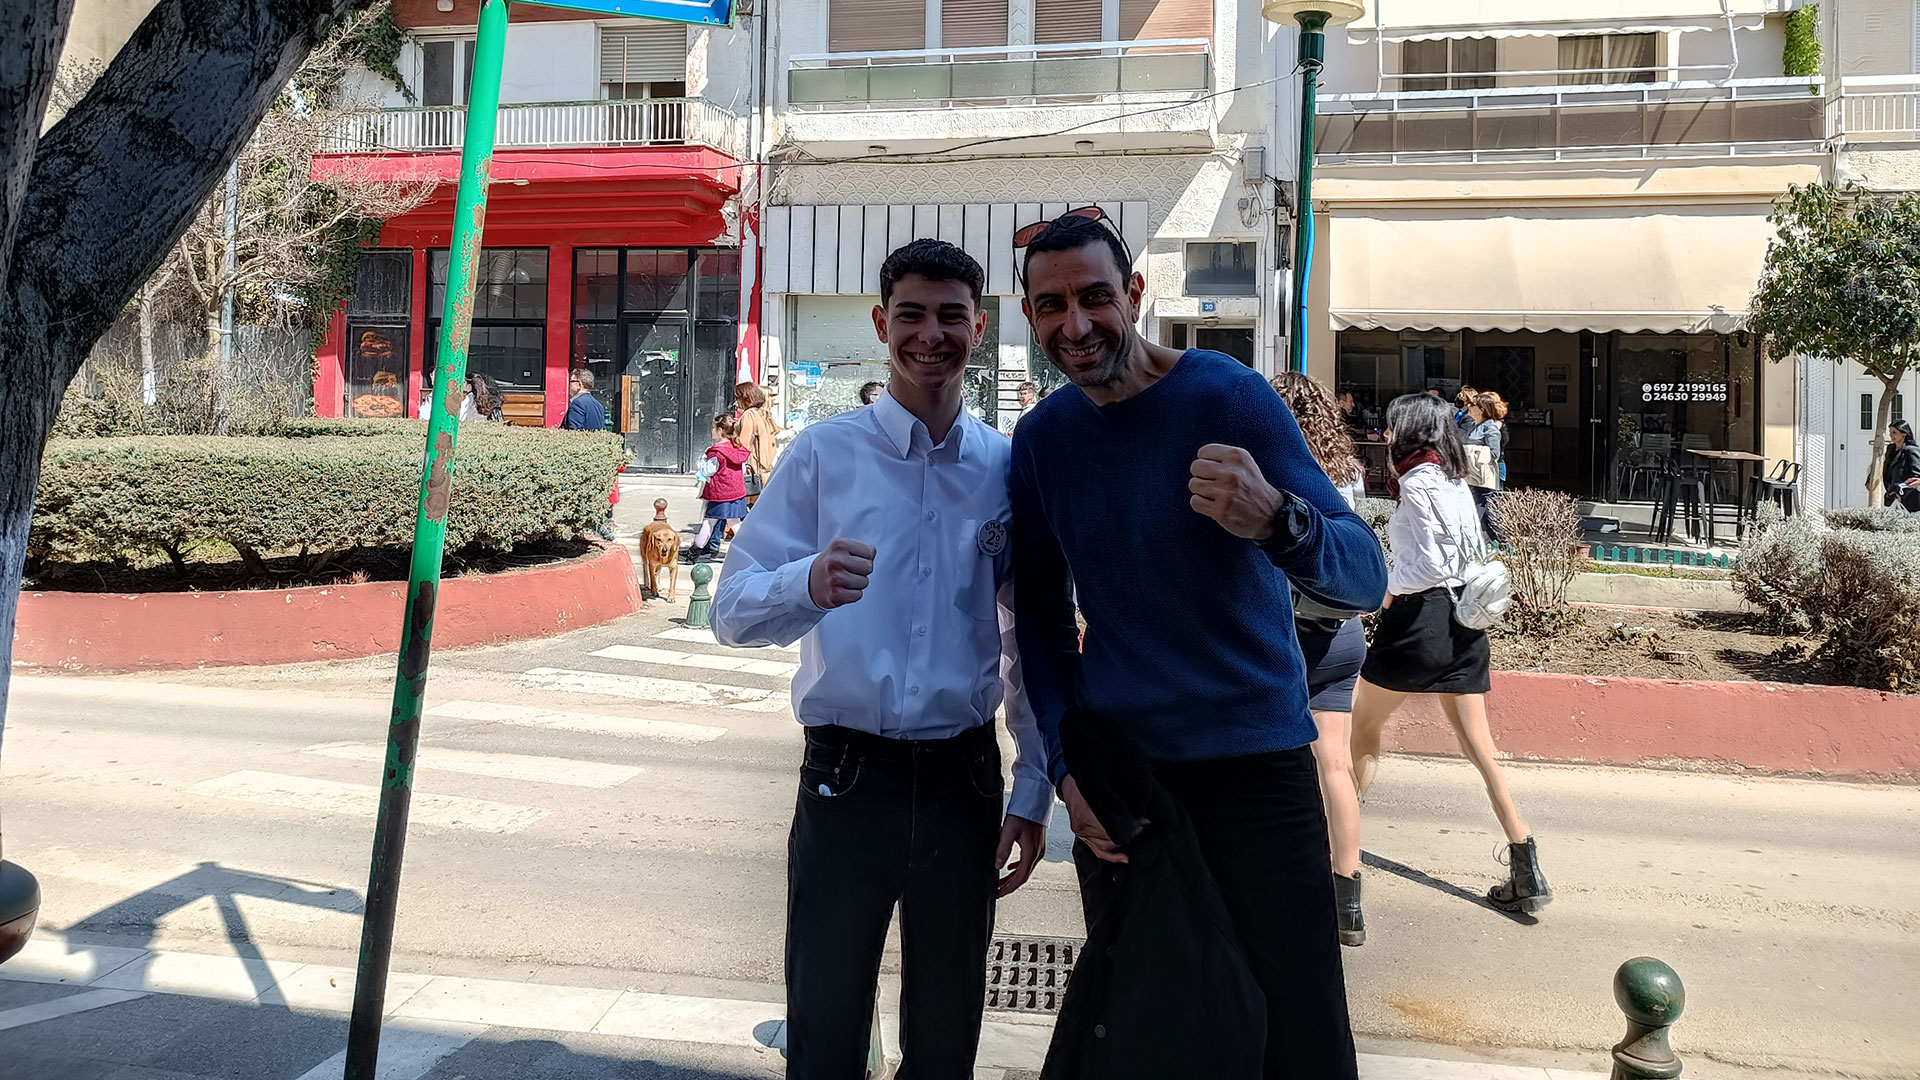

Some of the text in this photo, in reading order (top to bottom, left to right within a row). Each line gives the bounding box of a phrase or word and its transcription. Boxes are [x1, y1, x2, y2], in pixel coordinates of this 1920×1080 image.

[1653, 383, 1727, 392] 697 2199165
[1653, 393, 1727, 401] 24630 29949
